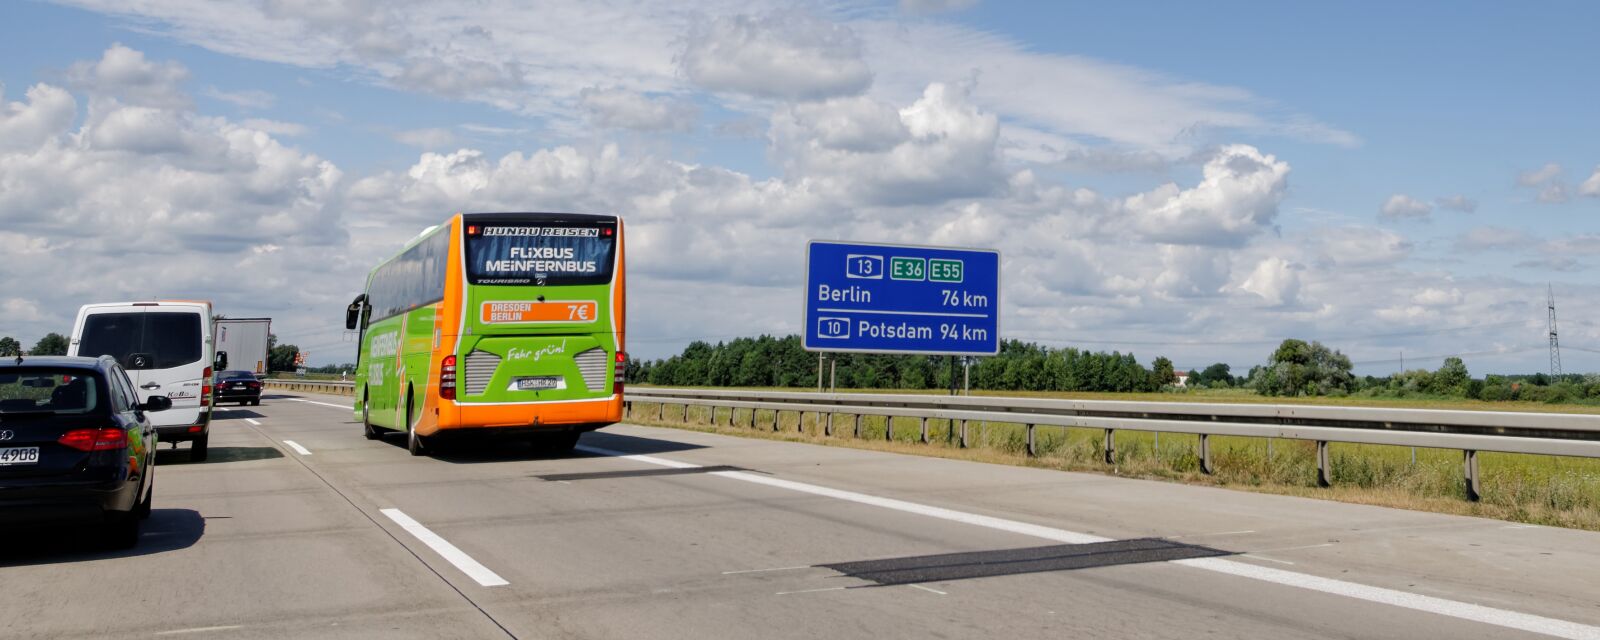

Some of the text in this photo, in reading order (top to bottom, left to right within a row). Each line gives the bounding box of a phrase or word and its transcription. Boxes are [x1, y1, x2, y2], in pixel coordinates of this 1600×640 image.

[541, 228, 599, 237] REISEN
[858, 260, 873, 274] 13
[818, 284, 988, 307] Berlin 76 km
[491, 303, 531, 312] DRESDEN
[568, 305, 588, 320] 7€
[491, 312, 522, 320] BERLIN
[828, 322, 840, 334] 10
[858, 320, 987, 341] Potsdam 94 km
[507, 347, 532, 361] Fahr
[1, 448, 37, 461] 4908
